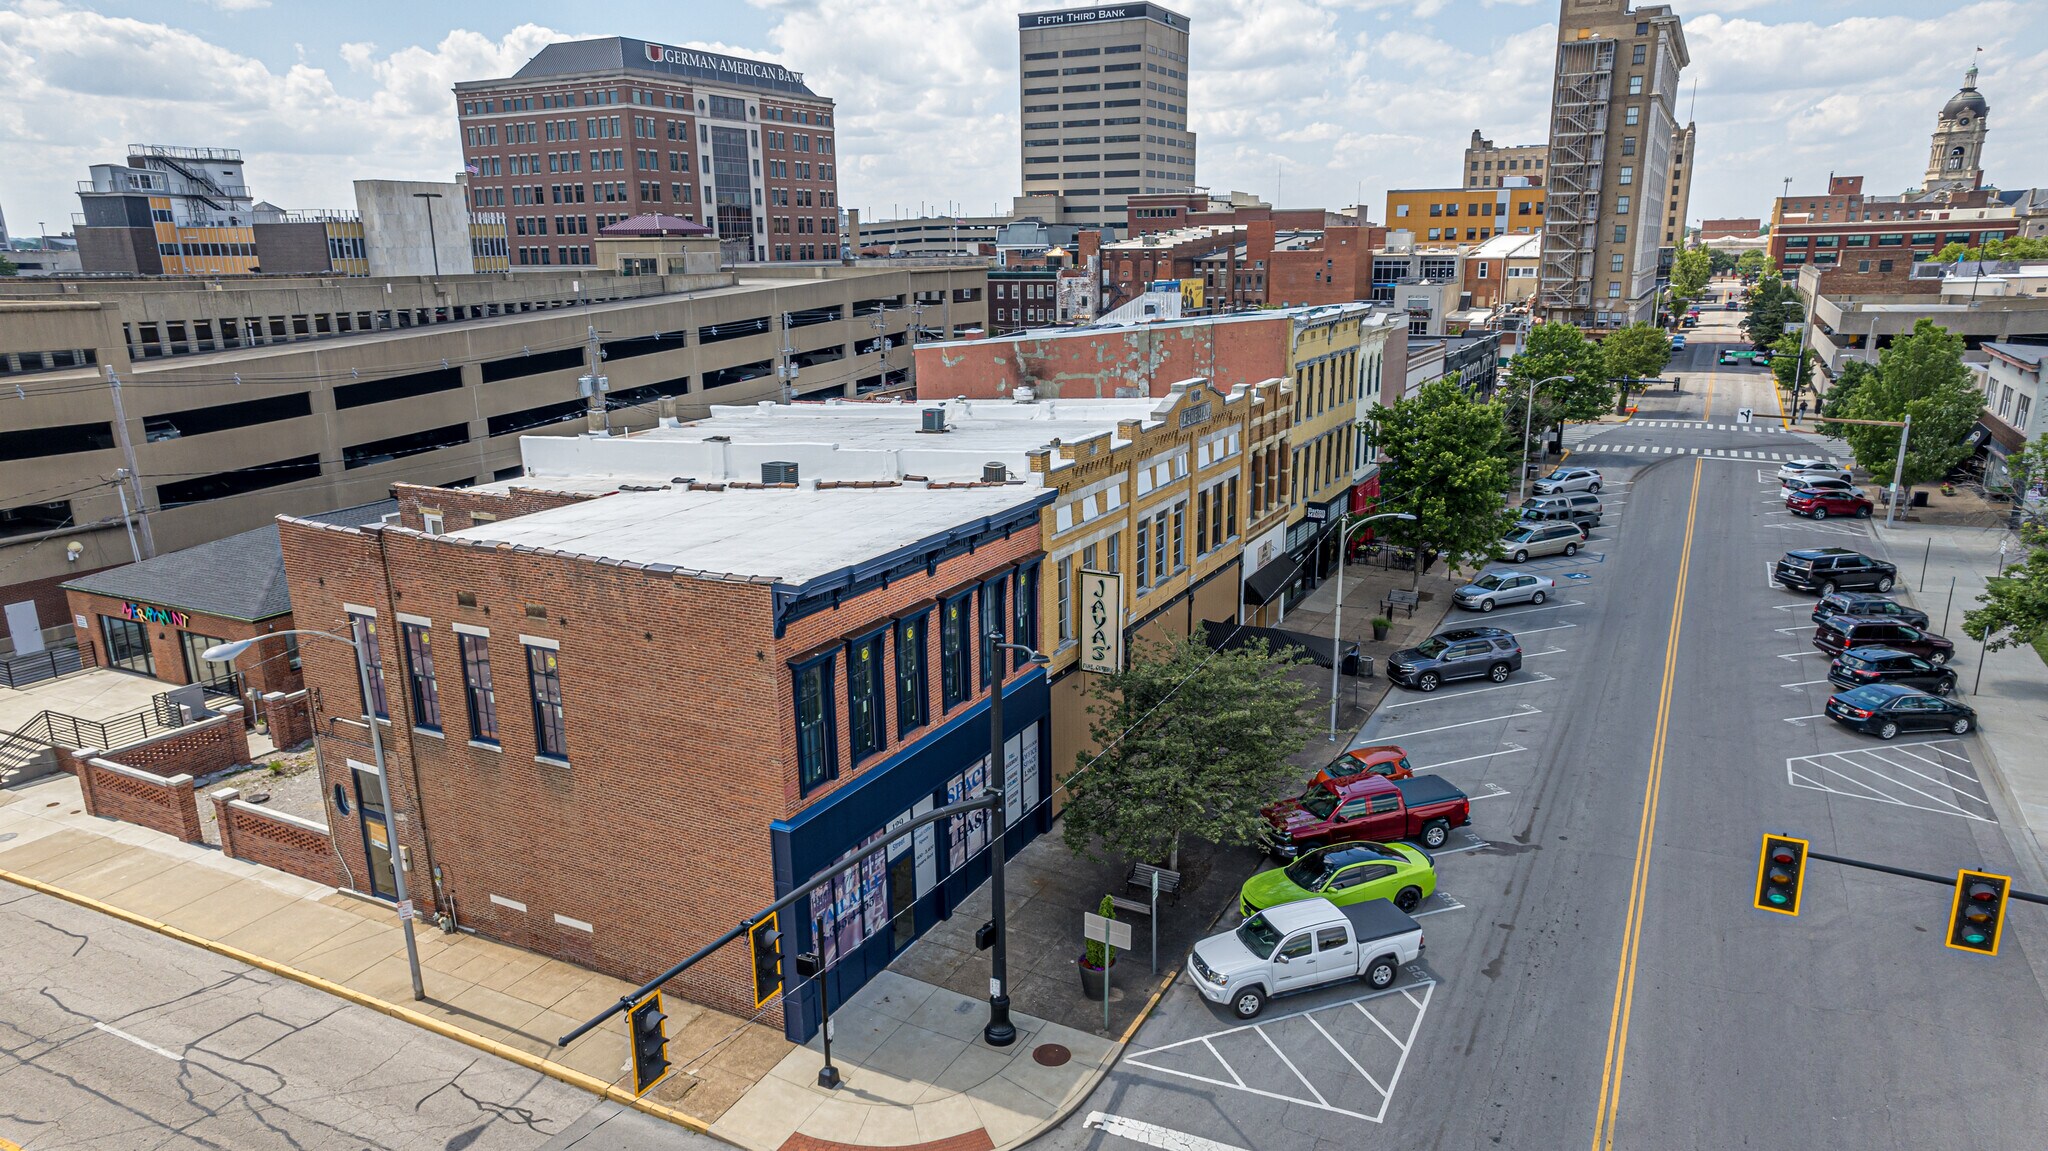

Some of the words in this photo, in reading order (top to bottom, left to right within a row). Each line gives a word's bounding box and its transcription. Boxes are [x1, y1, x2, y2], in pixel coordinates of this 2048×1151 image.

[1037, 15, 1064, 25] FIFTH
[1066, 12, 1096, 22] THIRD
[1099, 9, 1126, 19] BANK
[664, 49, 717, 70] GERMAN
[719, 58, 776, 80] AMERICAN
[778, 69, 805, 84] BANK
[1437, 892, 1461, 907] 133
[1405, 965, 1433, 983] 135
